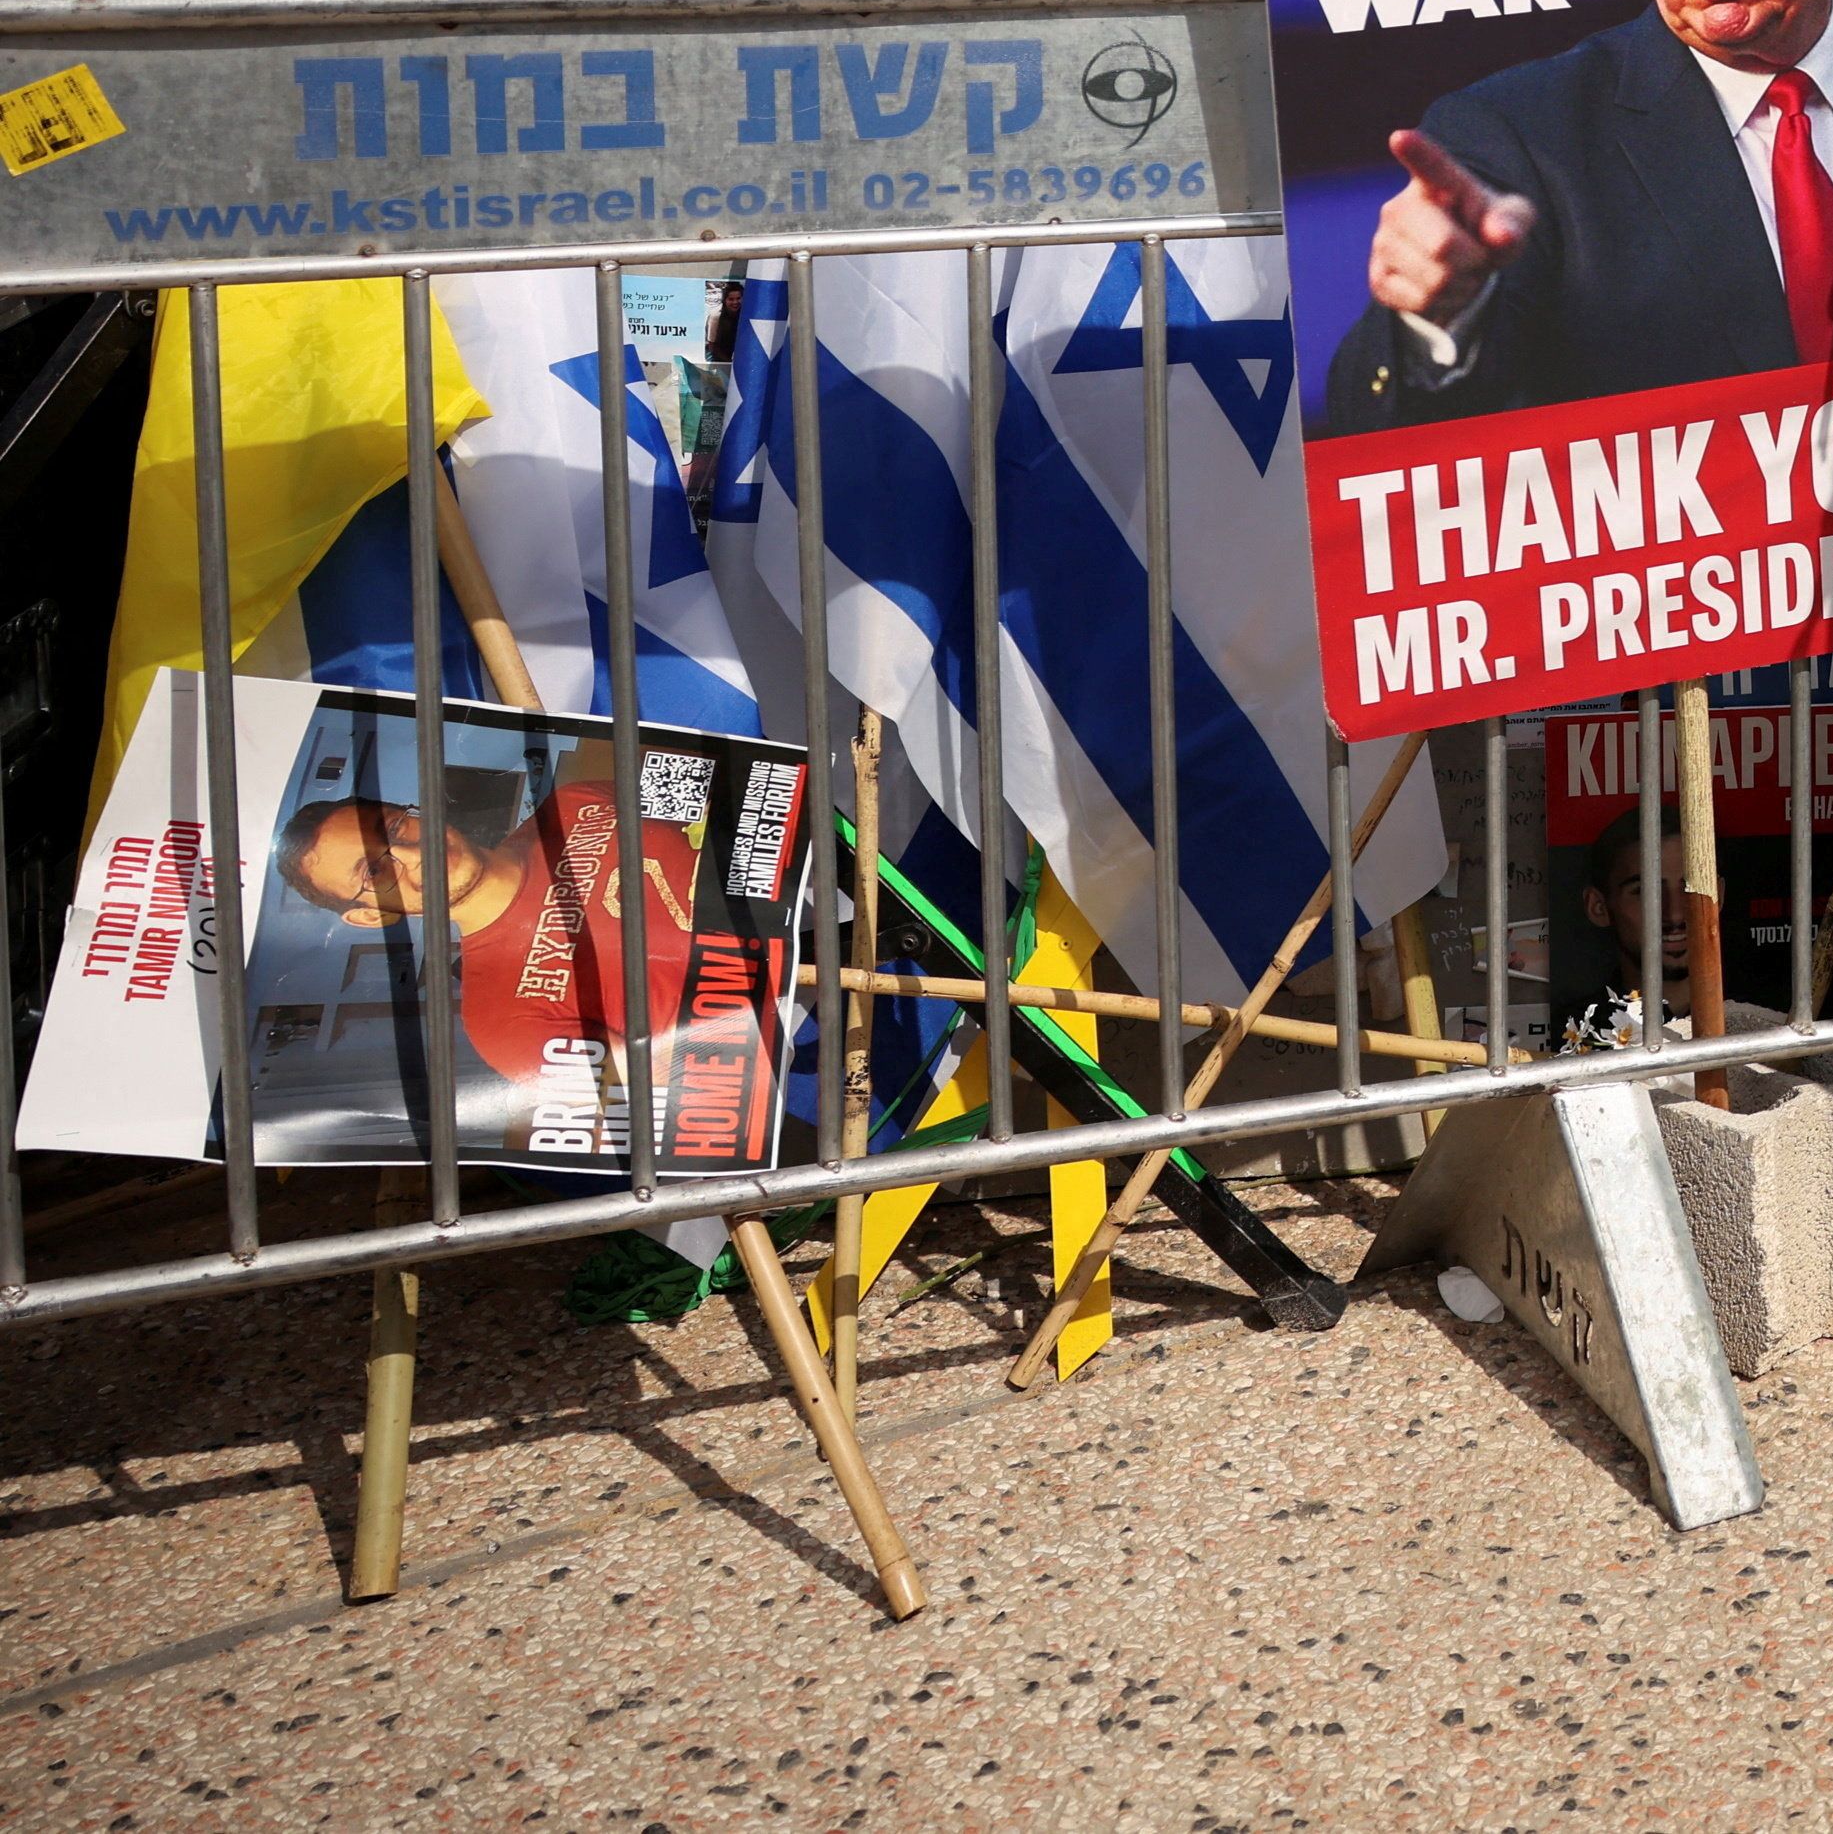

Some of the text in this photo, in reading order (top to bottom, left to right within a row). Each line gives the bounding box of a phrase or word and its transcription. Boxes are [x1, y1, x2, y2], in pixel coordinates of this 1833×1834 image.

[295, 40, 1045, 158] קשת במות
[105, 159, 1207, 241] www.kstisrael.co.il 02-5839696
[1339, 420, 1724, 594] THANK
[1354, 600, 1516, 705] MR.
[727, 762, 770, 897] HOSTAGES AND MISSING
[746, 765, 801, 900] FAMILIES FORUM
[83, 837, 154, 976] תמיר נמרודי
[125, 821, 205, 1001] TAMIR NIMRODI
[529, 1036, 606, 1153] BRING
[674, 931, 763, 1157] HOME NOW!
